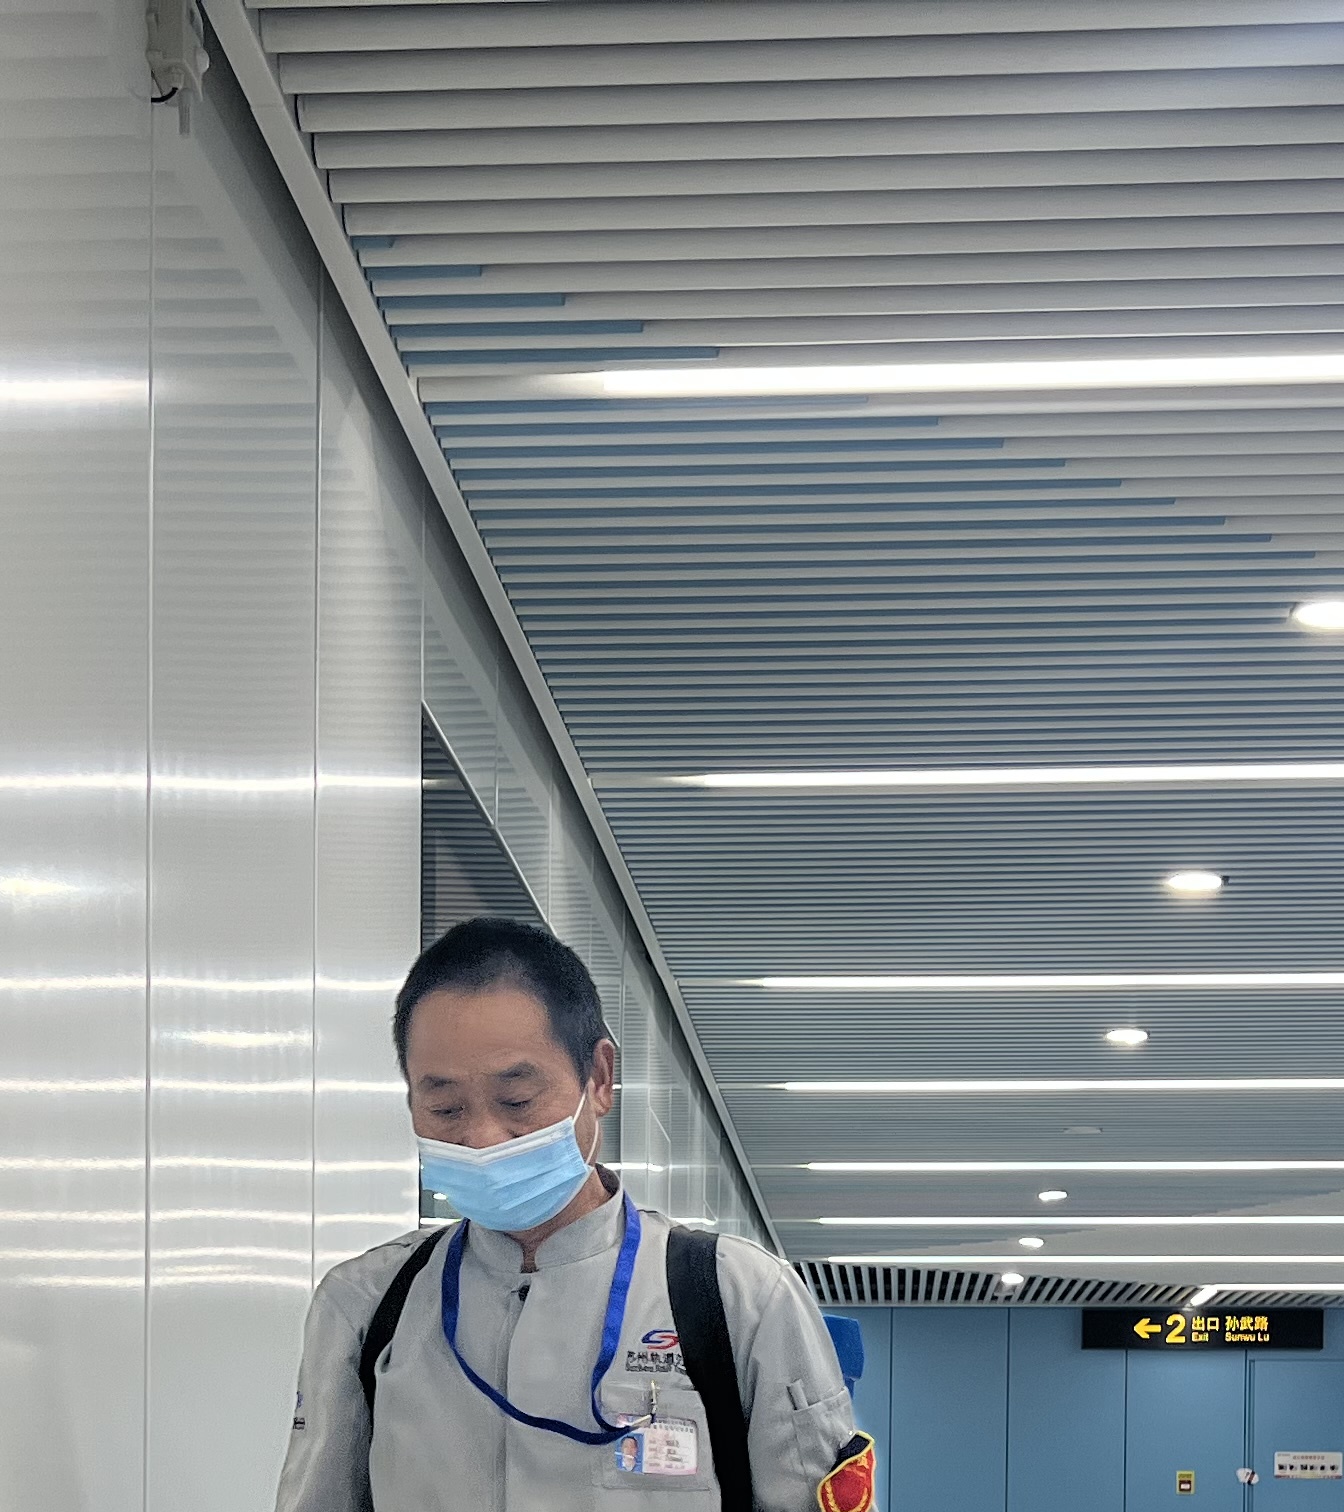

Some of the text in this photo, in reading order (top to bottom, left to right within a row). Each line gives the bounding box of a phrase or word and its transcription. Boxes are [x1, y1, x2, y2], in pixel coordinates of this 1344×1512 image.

[1166, 1314, 1186, 1343] 2
[1192, 1315, 1269, 1331] 出口 孙武路
[1192, 1332, 1270, 1342] Exit Sunwu Lu
